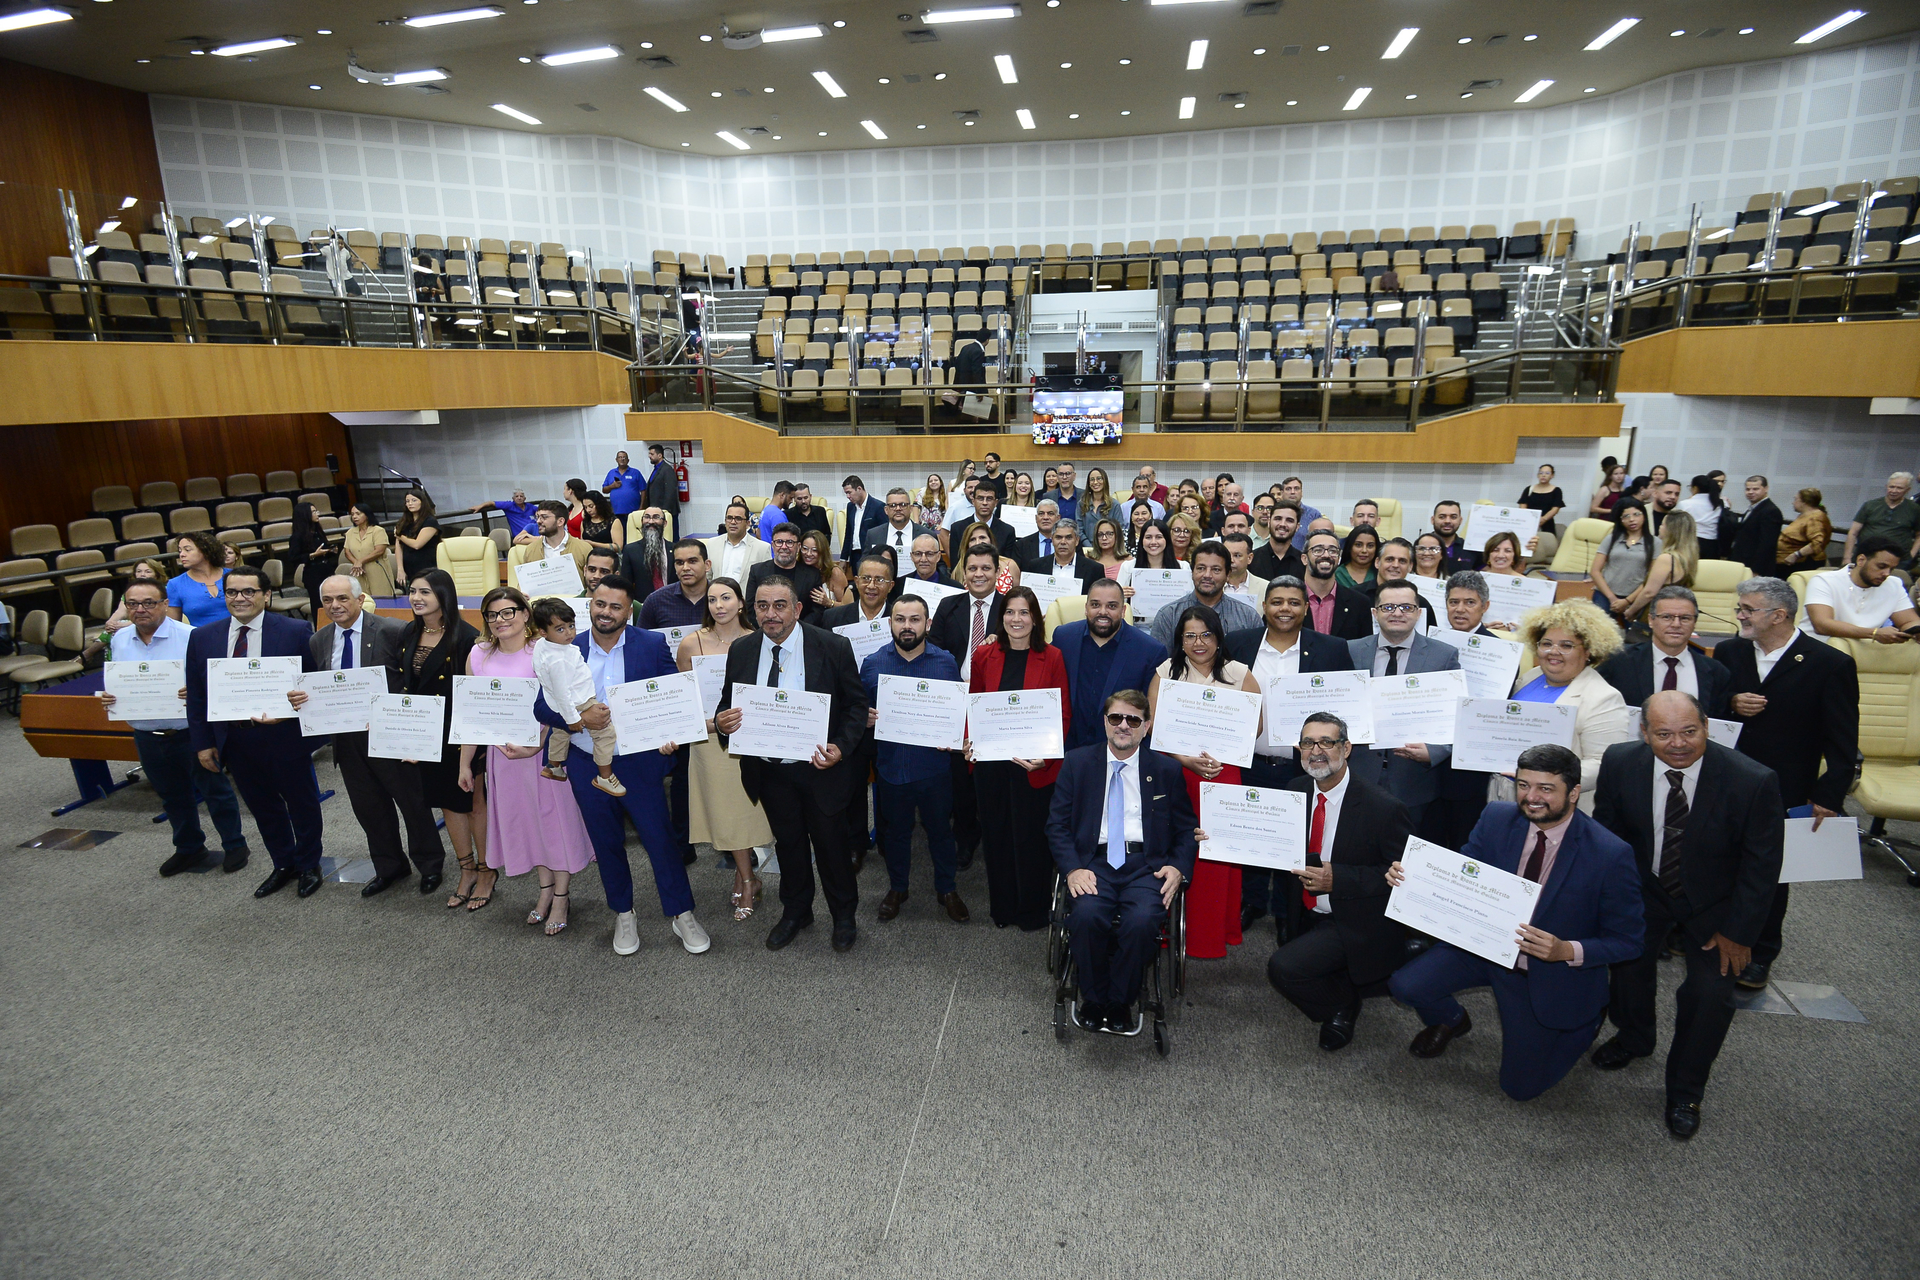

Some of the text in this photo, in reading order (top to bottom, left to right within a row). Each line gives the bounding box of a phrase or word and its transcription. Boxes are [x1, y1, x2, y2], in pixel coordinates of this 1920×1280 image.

[1176, 697, 1195, 705] Diploma
[1269, 805, 1287, 813] Mérito
[1426, 861, 1451, 876] Diploma
[1459, 875, 1479, 887] Honra
[1488, 887, 1510, 899] Mérito
[1431, 872, 1450, 882] Câmara
[1450, 879, 1474, 892] Municipal
[1480, 891, 1500, 902] Goiânia
[1432, 892, 1488, 918] Rangel Francisco Pinto
